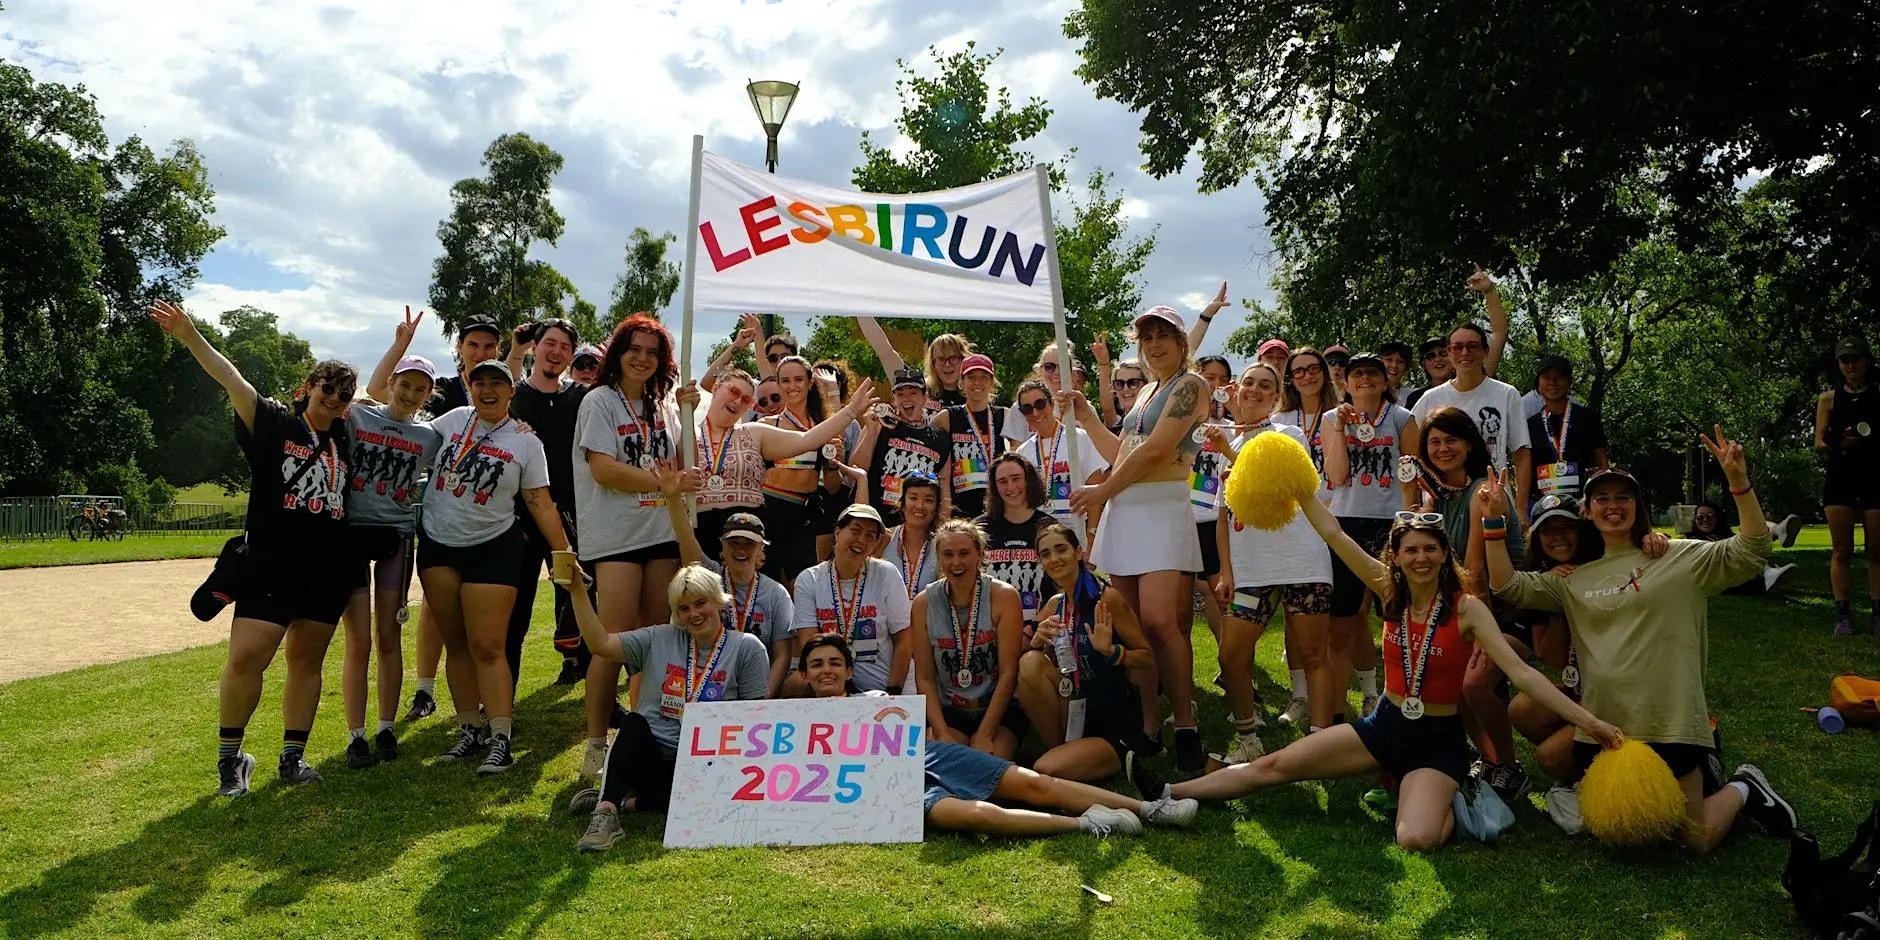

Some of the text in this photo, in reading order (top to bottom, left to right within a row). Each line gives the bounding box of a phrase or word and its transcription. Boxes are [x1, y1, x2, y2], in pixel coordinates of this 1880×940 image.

[699, 195, 1045, 287] LESBIRUN
[1414, 627, 1434, 680] Melbourne
[1427, 601, 1443, 625] Pride
[807, 723, 922, 757] RUN!
[731, 764, 866, 804] 2025
